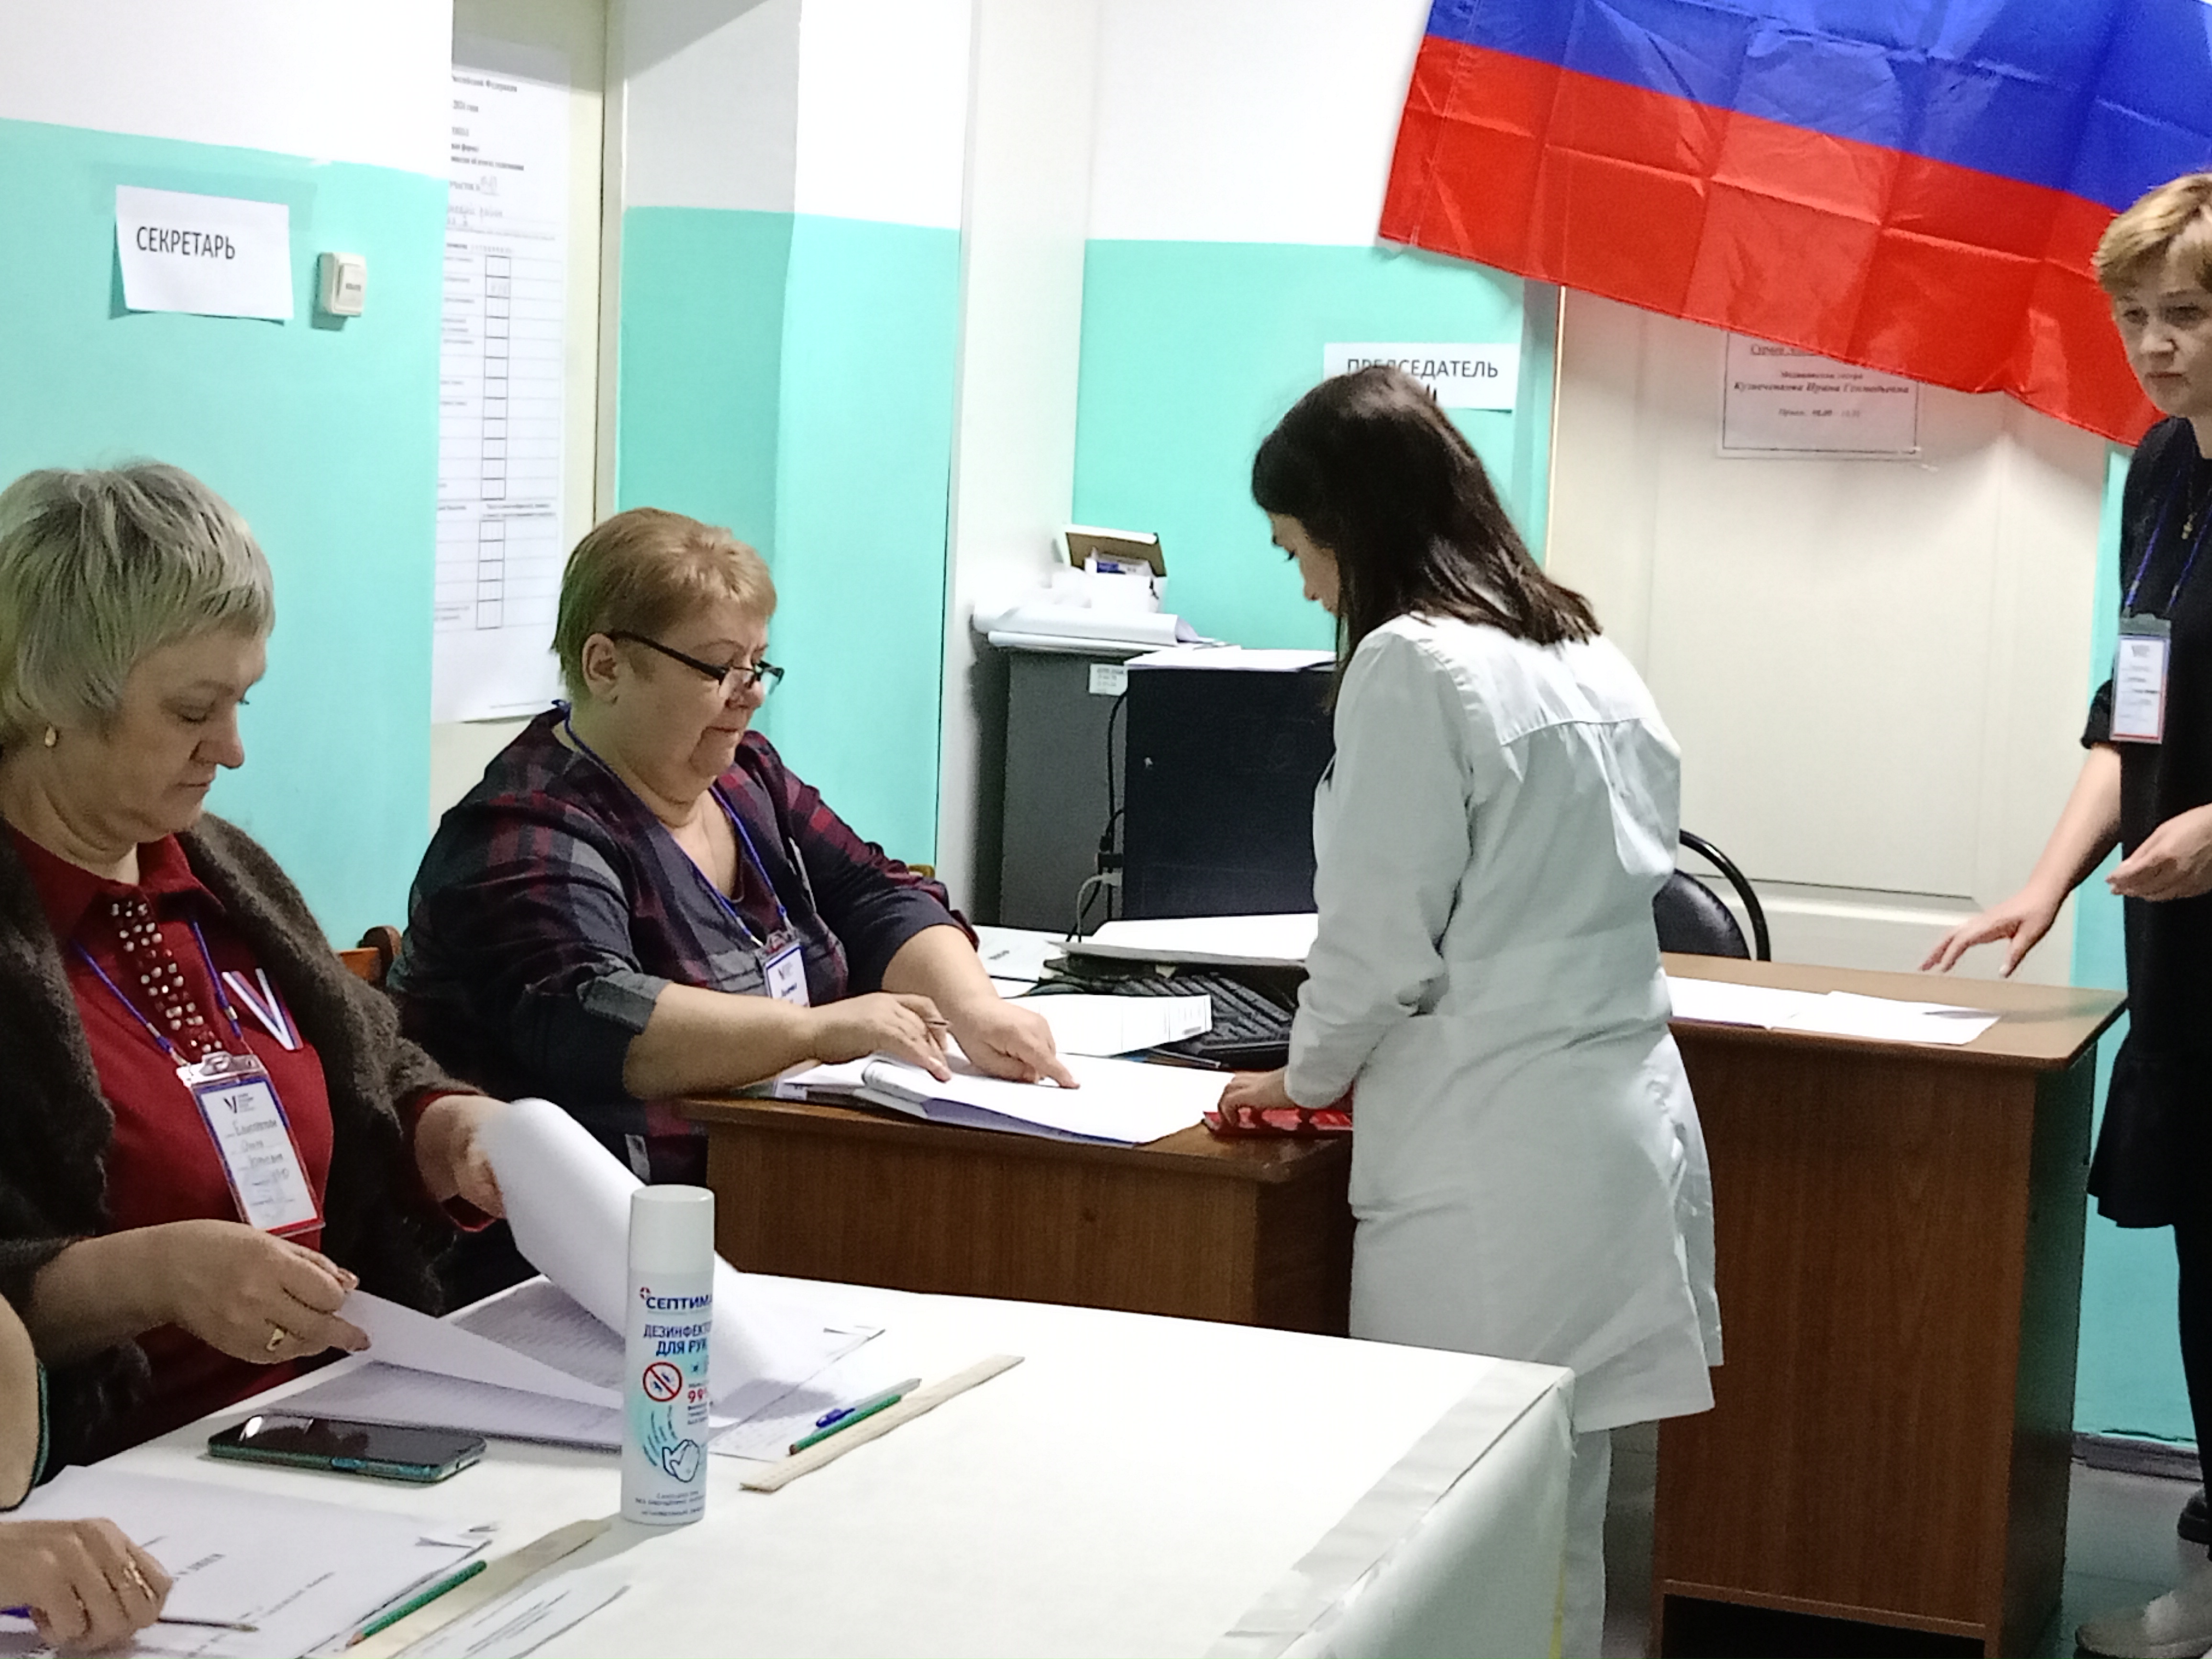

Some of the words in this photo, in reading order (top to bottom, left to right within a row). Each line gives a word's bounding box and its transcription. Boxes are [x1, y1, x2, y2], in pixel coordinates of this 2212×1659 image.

[137, 226, 236, 260] СЕКРЕТАРЬ
[646, 1294, 712, 1310] СЕПТИМ
[656, 1340, 685, 1357] ДЛЯ
[688, 1338, 707, 1353] РУК
